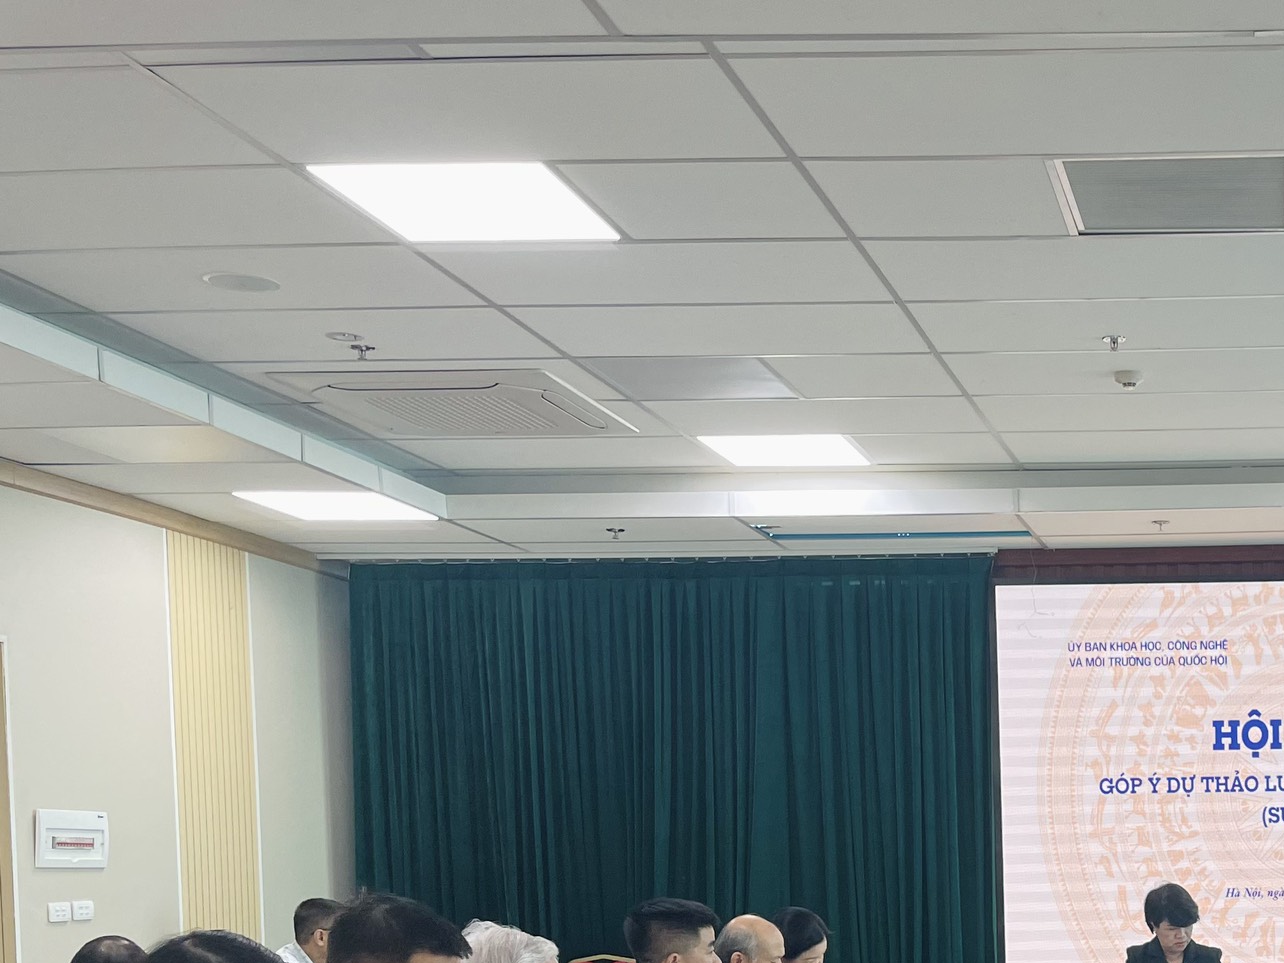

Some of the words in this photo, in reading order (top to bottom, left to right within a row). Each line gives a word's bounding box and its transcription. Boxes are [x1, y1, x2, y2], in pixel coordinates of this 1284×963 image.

[1085, 641, 1107, 651] BAN
[1110, 641, 1138, 651] KHOA
[1167, 639, 1198, 651] CÔNG
[1212, 709, 1282, 758] HỘI
[1099, 773, 1143, 794] GÓP
[1148, 772, 1161, 794] Ý
[1166, 774, 1196, 797] DỰ
[1201, 770, 1259, 793] THẢO
[1225, 888, 1241, 898] Hà
